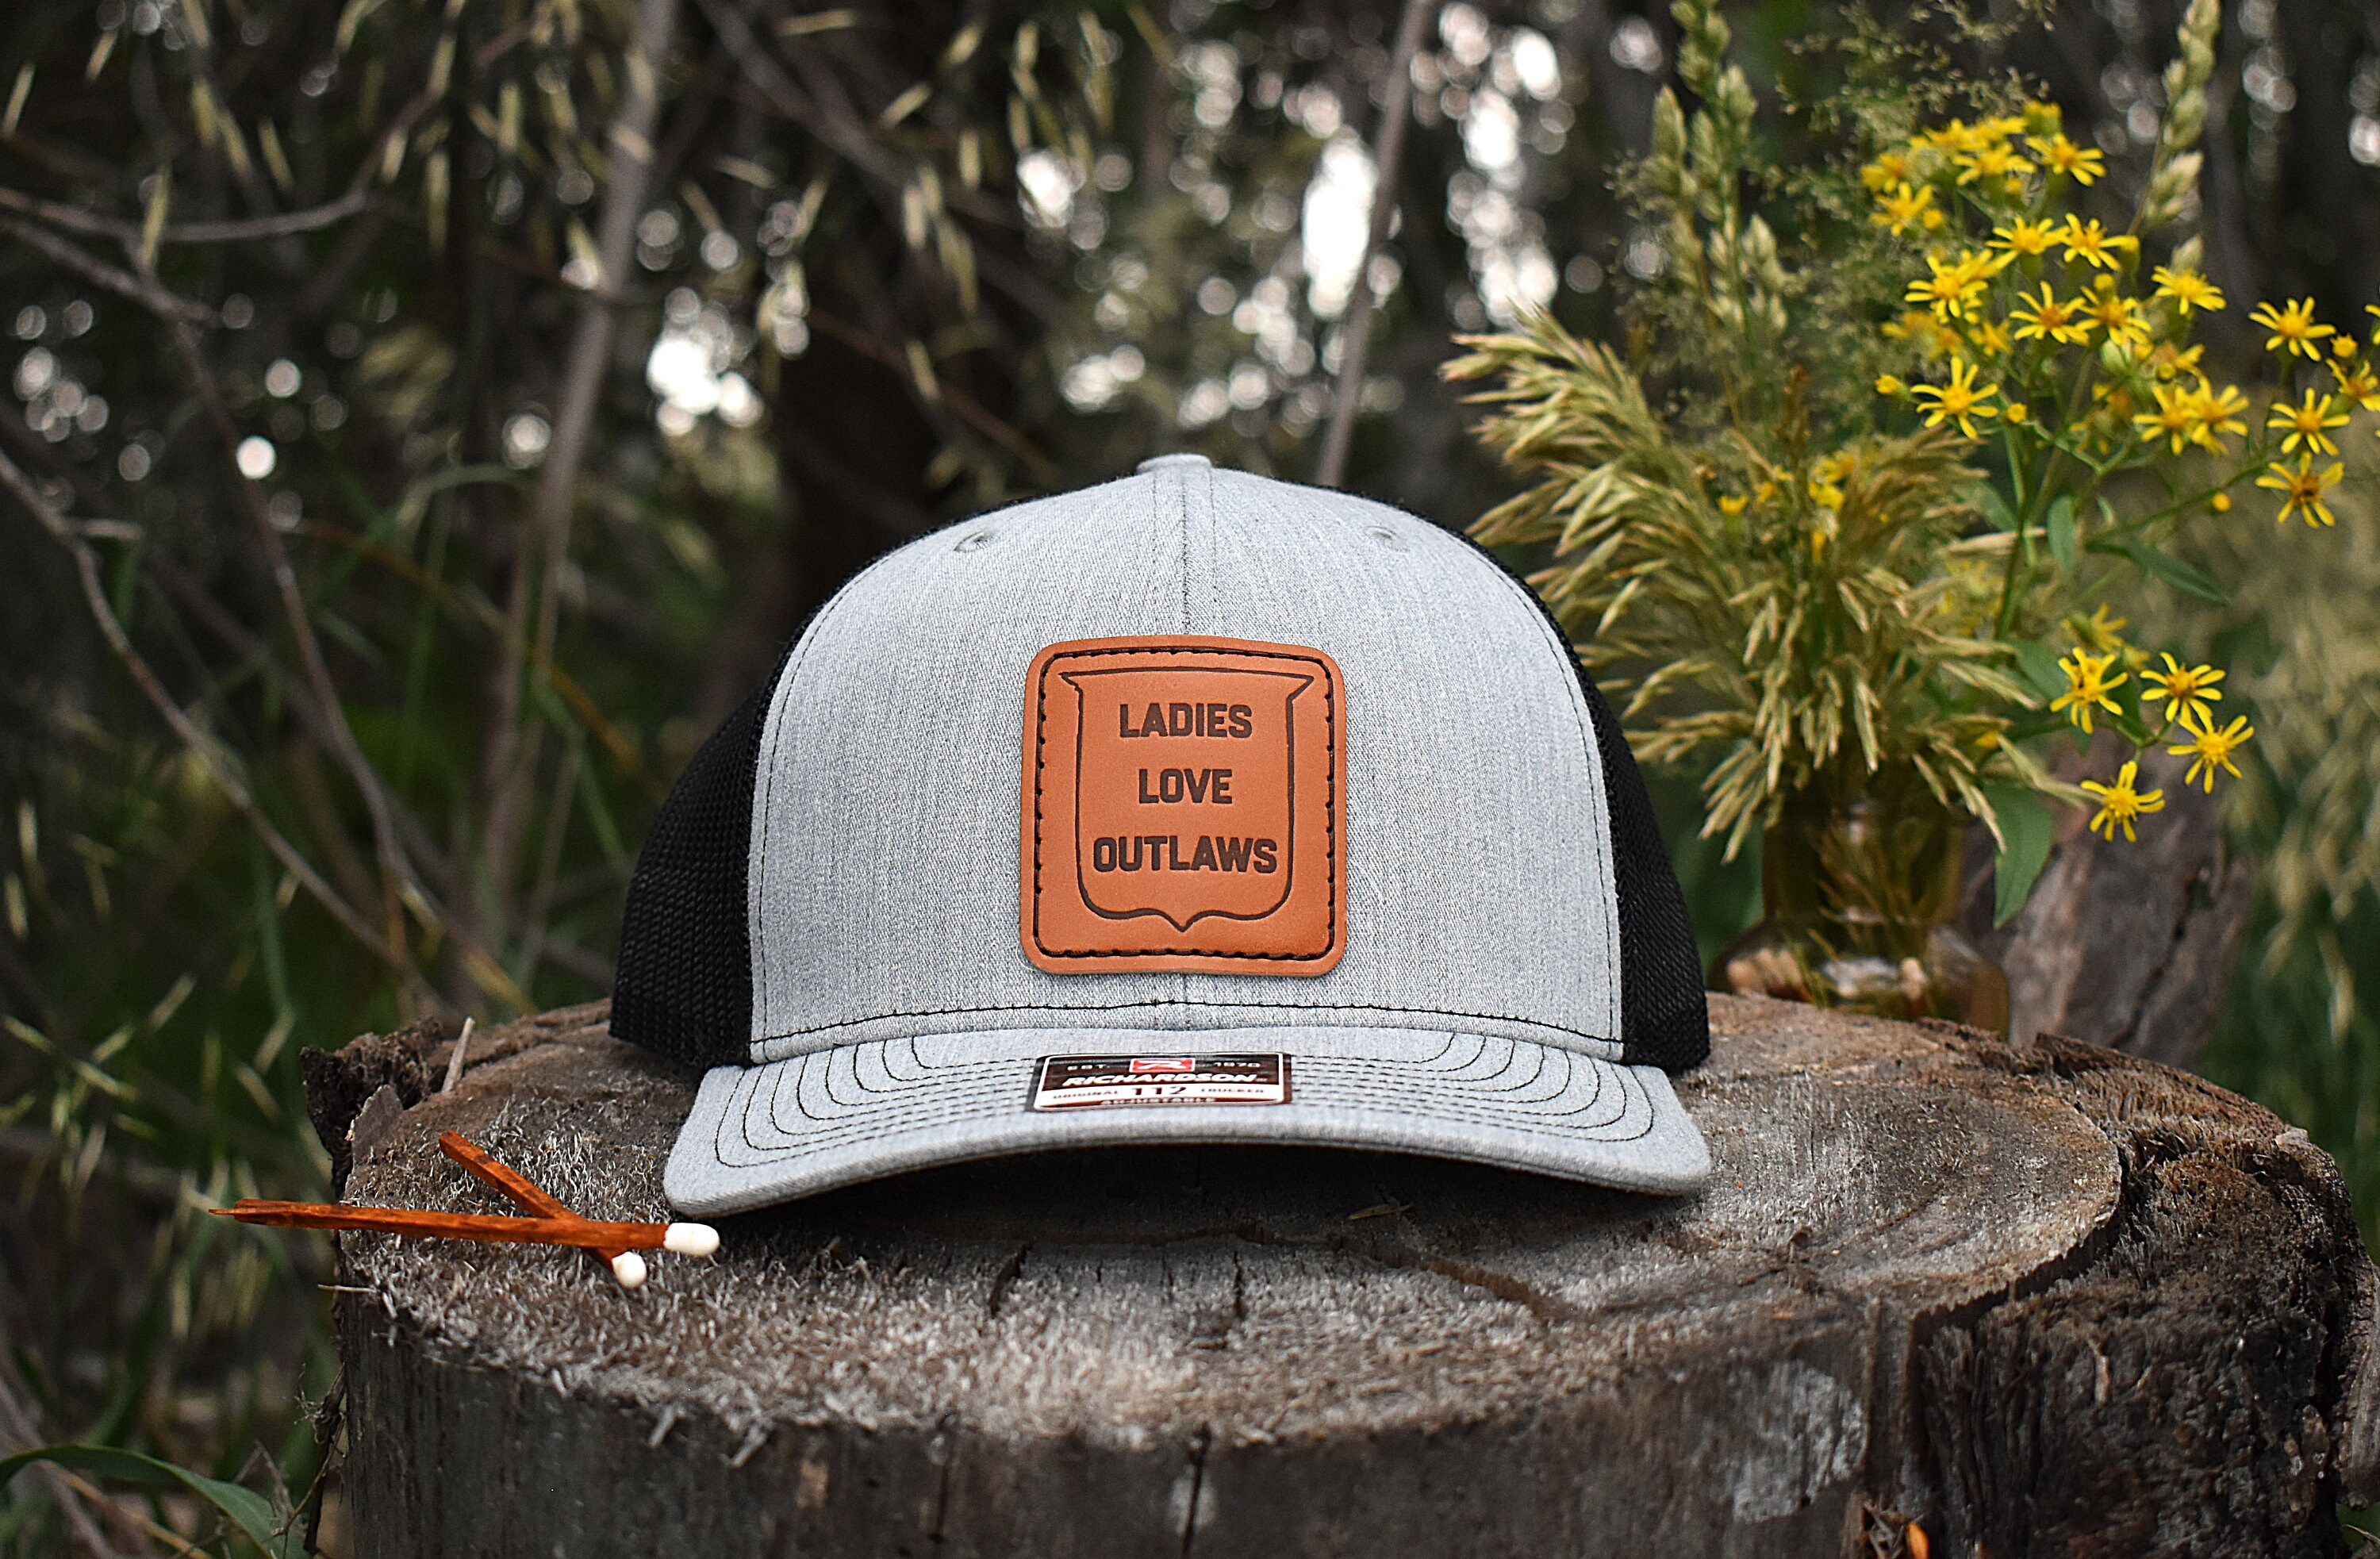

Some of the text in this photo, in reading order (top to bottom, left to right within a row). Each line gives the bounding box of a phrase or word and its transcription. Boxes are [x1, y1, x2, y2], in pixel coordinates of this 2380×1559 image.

[1119, 703, 1253, 738] LADIES
[1138, 768, 1233, 804] LOVE
[1093, 835, 1277, 874] OUTLAWS
[1061, 1073, 1257, 1086] RICHARDSON
[1131, 1086, 1187, 1096] 112
